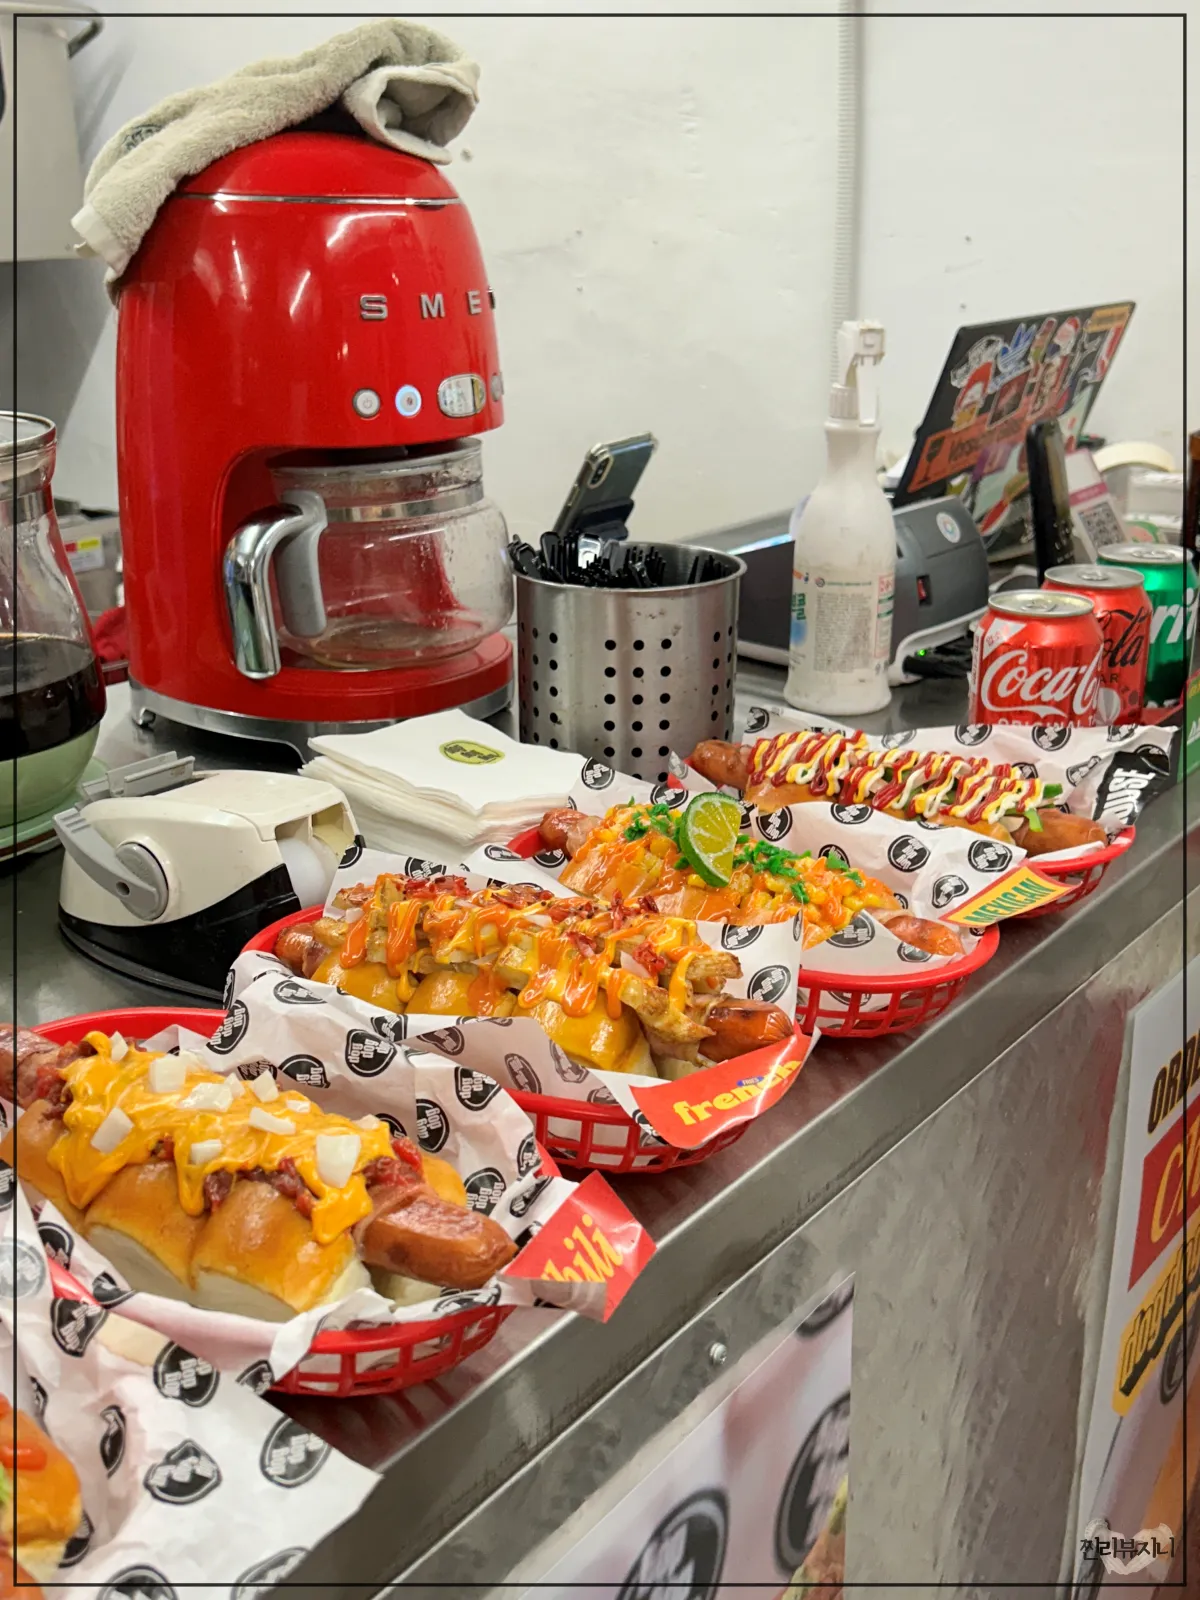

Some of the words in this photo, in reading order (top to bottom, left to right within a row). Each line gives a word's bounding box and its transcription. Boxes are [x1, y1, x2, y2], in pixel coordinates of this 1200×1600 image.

[360, 288, 496, 320] SME
[1098, 766, 1156, 826] OUSE
[963, 877, 1057, 924] MEXICAN
[541, 1213, 624, 1283] hili
